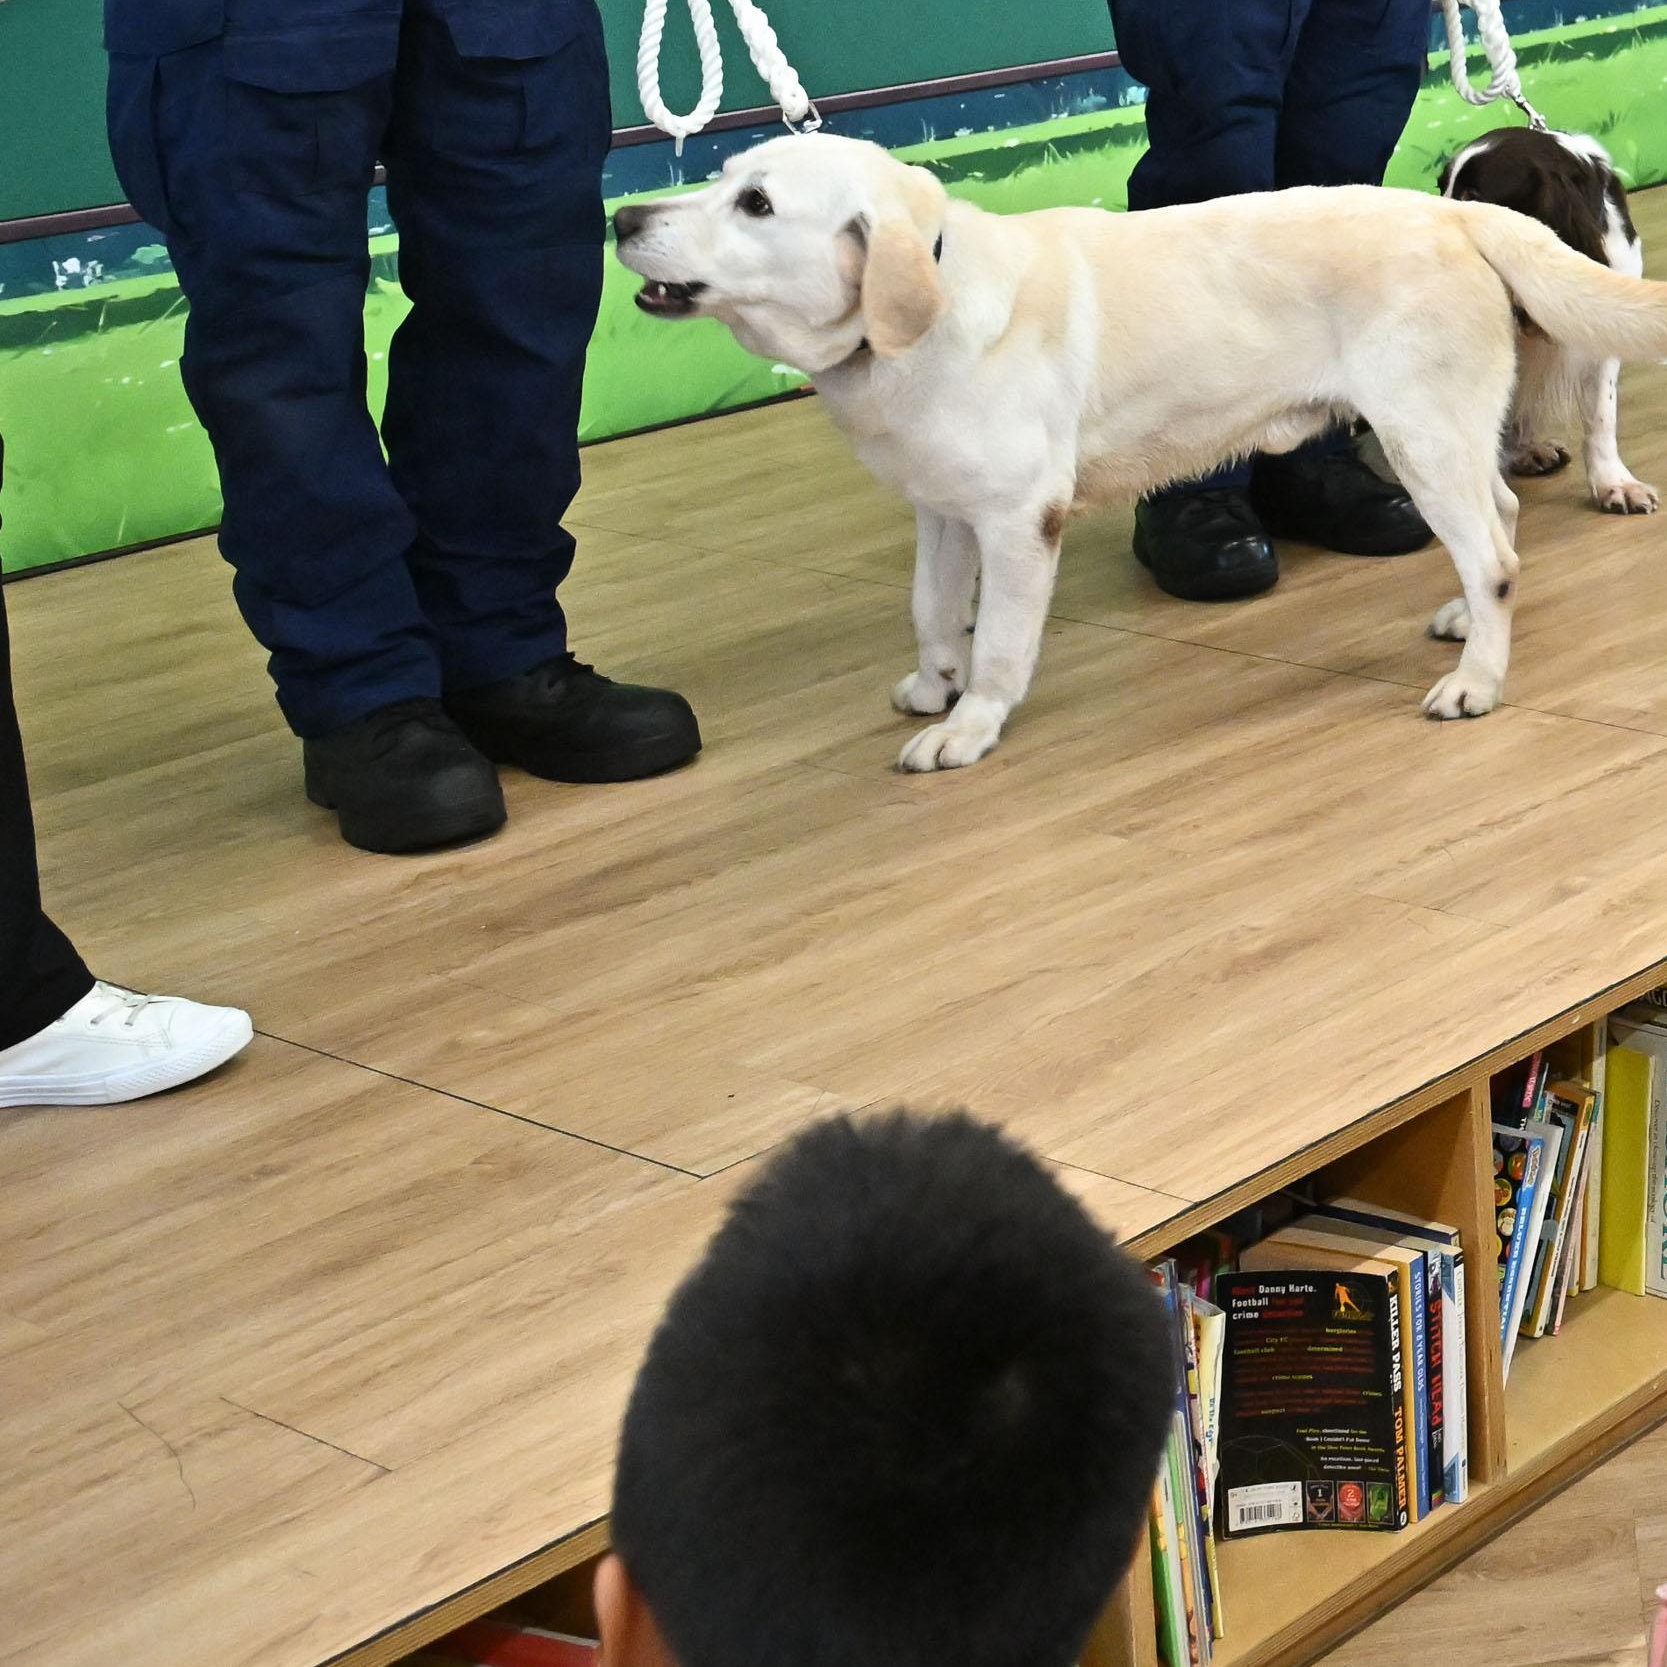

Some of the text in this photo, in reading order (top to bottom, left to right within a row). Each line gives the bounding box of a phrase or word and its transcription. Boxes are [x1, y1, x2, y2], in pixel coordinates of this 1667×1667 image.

[1258, 1284, 1286, 1296] Danny
[1414, 1271, 1422, 1313] STORIES
[1232, 1297, 1269, 1308] Football
[1232, 1311, 1260, 1320] crime
[1415, 1314, 1423, 1333] FOR
[1416, 1340, 1424, 1367] YEAR
[1417, 1367, 1425, 1392] OLDS
[1389, 1294, 1408, 1511] KILLER PASS TOM PALMER
